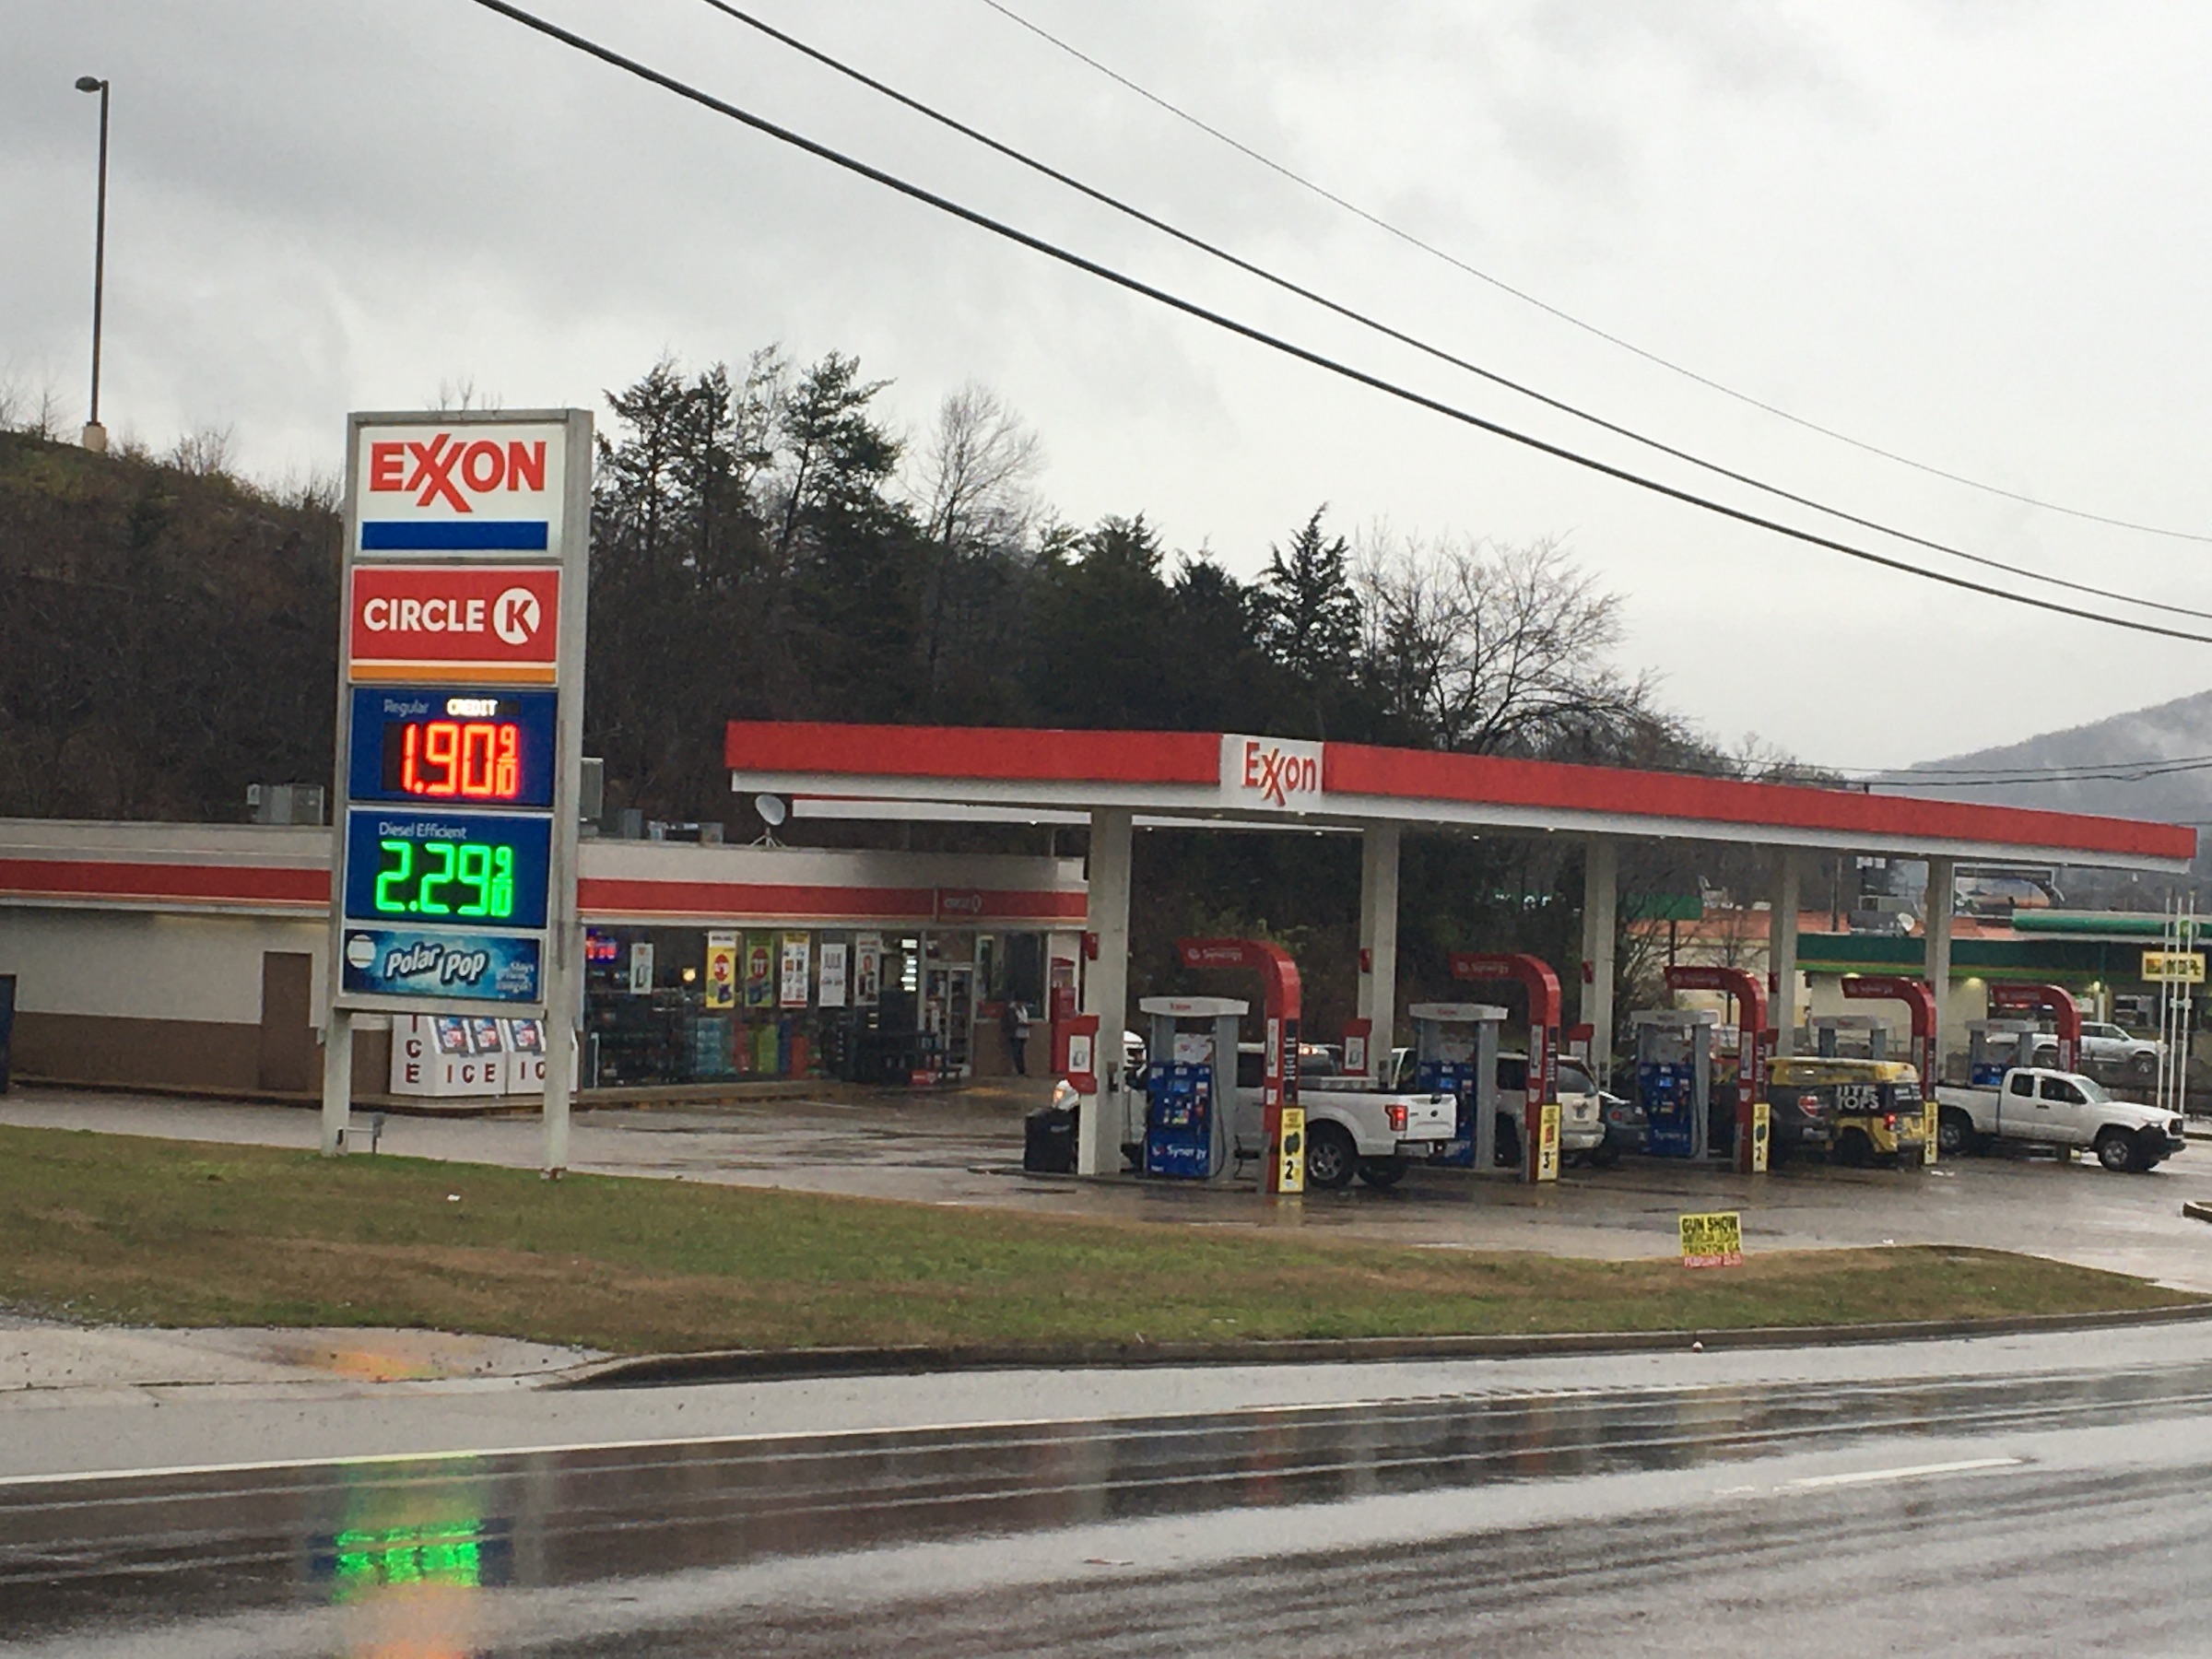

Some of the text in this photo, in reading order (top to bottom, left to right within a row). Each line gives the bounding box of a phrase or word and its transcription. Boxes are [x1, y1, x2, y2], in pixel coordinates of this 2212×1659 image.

[371, 433, 546, 512] EXXON
[363, 597, 538, 642] CIRCLE K
[383, 699, 429, 717] Regular
[447, 698, 499, 716] CREDIT
[1244, 741, 1317, 806] Exxon
[379, 821, 467, 840] Diesel Efficient
[385, 944, 487, 982] Polar Pop
[447, 1063, 496, 1084] ICE
[520, 1061, 546, 1080] IC
[1838, 1096, 1879, 1111] TOPS
[1166, 1144, 1207, 1160] Synergy
[1285, 1159, 1294, 1181] 2
[1682, 1215, 1738, 1234] GUN SHOW
